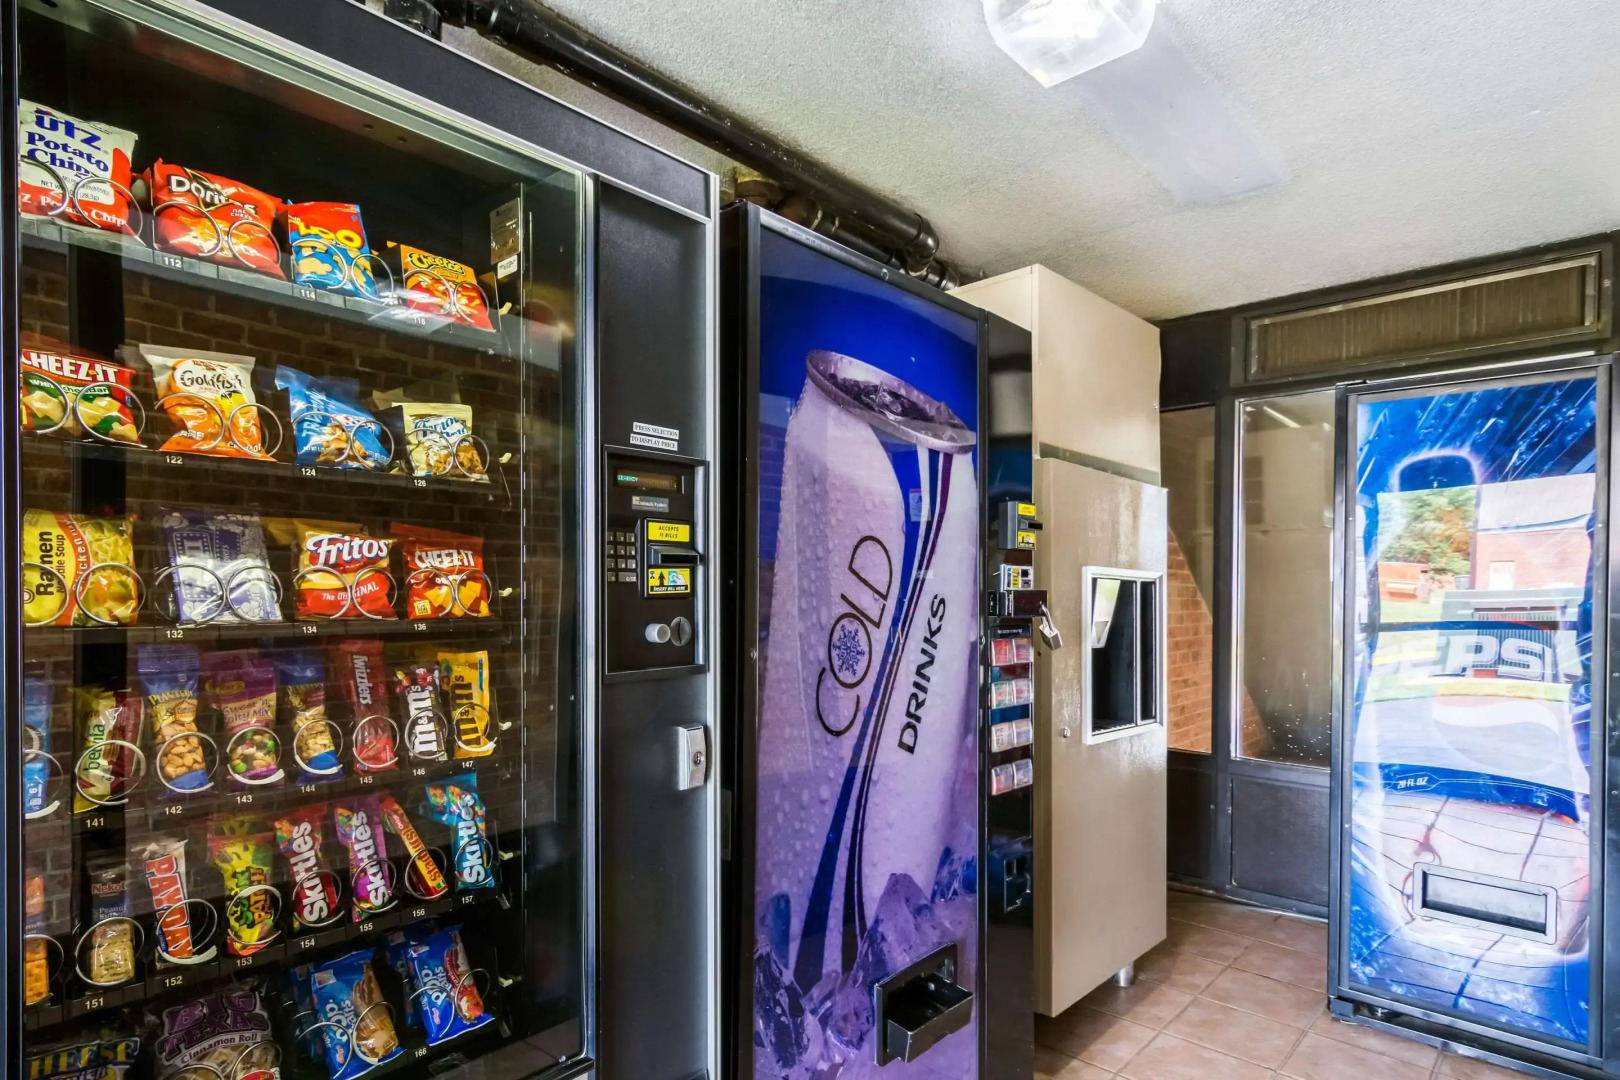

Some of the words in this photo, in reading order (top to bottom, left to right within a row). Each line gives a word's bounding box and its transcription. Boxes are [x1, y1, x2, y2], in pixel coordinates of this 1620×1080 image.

[25, 130, 109, 172] Potato
[164, 256, 182, 268] 112
[409, 252, 465, 276] Cheetos
[300, 289, 316, 299] 114
[635, 424, 651, 432] PRESS
[652, 428, 678, 436] SELECTION
[639, 437, 660, 446] DISPLAY
[166, 456, 182, 464] 122
[301, 468, 316, 476] 124
[56, 534, 66, 558] Soup
[306, 534, 388, 566] Fritos
[322, 592, 335, 600] The
[166, 630, 184, 639] 132
[302, 626, 317, 634] 134
[815, 534, 894, 738] COLD
[898, 592, 947, 755] DRINKS
[353, 655, 372, 705] Twizzlers
[412, 768, 426, 776] 146
[359, 776, 373, 784] 145
[300, 784, 316, 793] 144
[236, 795, 253, 804] 143
[164, 805, 182, 815] 142
[86, 817, 105, 828] 141
[402, 827, 441, 882] Starburst
[462, 896, 473, 904] 157
[144, 854, 194, 959] PAYDAY
[412, 908, 425, 918] 156
[359, 922, 373, 932] 155
[300, 938, 315, 948] 154
[236, 957, 253, 967] 153
[165, 976, 182, 988] 152
[85, 997, 104, 1010] 151
[166, 991, 256, 1034] BIG
[157, 1011, 268, 1061] TEXAS
[181, 1037, 236, 1064] Cinnamon
[239, 1033, 257, 1043] Roll
[415, 1048, 427, 1058] 166
